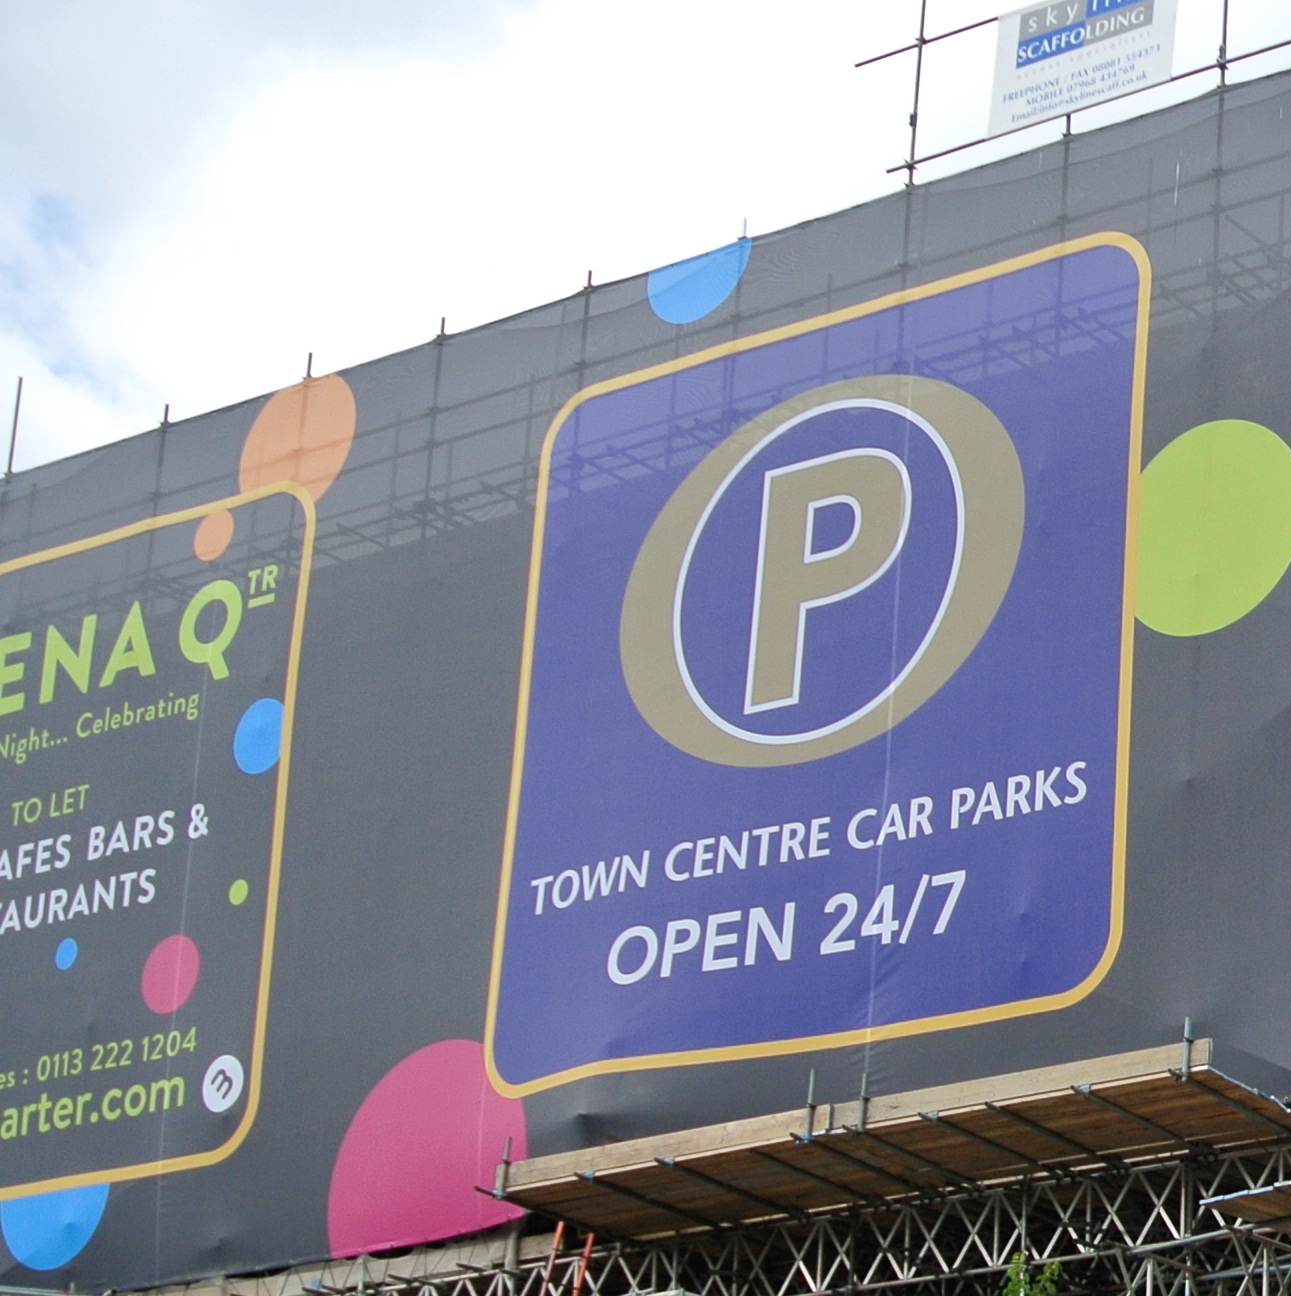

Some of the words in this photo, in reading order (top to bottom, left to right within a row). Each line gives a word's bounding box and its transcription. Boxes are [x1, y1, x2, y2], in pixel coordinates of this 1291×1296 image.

[1017, 7, 1145, 63] SCAFFOLDING
[1003, 78, 1060, 103] FREEPHONE
[1071, 67, 1089, 80] FAX
[1025, 87, 1063, 107] MOBILE
[744, 447, 912, 715] P
[76, 691, 200, 738] Celebrating
[11, 797, 42, 826] TO
[50, 784, 90, 818] LET
[87, 811, 175, 861] BARS
[188, 803, 209, 839] &
[530, 850, 650, 915] TOWN
[664, 816, 831, 881] CENTRE
[846, 796, 934, 850] CAR
[949, 760, 1087, 830] PARKS
[606, 901, 796, 985] OPEN
[819, 870, 967, 955] 24/7
[37, 1047, 83, 1082] 0113
[90, 1040, 133, 1071] 222
[142, 1026, 196, 1062] 1204
